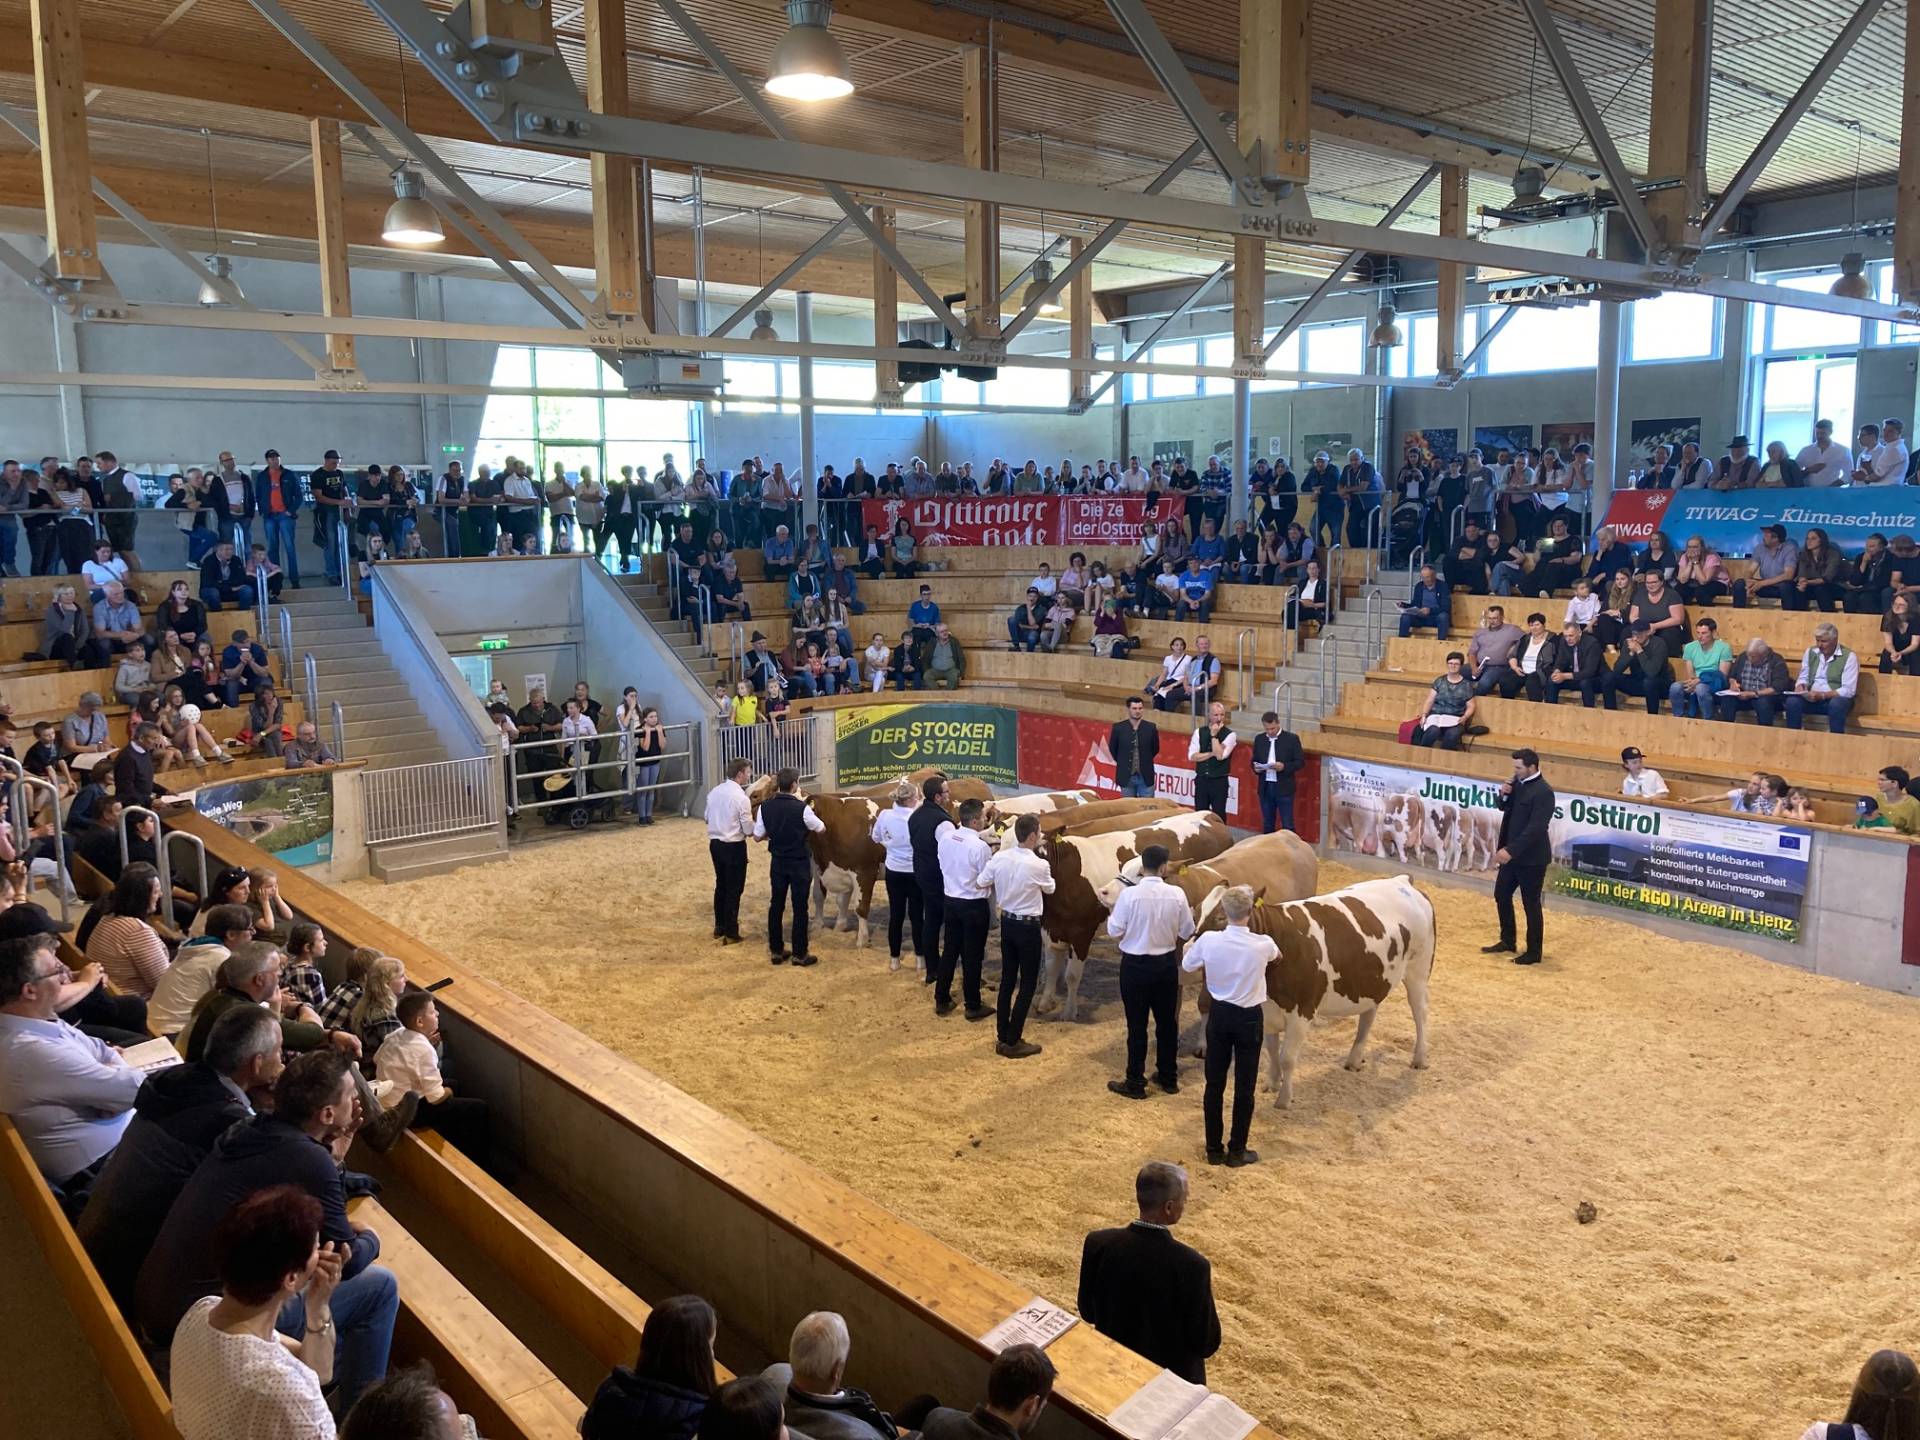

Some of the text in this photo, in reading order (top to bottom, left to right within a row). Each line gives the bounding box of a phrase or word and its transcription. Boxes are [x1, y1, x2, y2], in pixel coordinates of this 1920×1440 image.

[1081, 503, 1103, 517] Die
[1685, 507, 1759, 521] TIWAG
[1779, 508, 1917, 528] Klimaschutz
[1073, 522, 1097, 536] der
[870, 728, 907, 744] DER
[910, 722, 995, 739] STOCKER
[922, 739, 991, 756] STADEL
[1571, 799, 1661, 836] Osttirol
[1650, 842, 1704, 859] kontrollierte
[1706, 851, 1764, 869] Melkbarkeit
[1650, 856, 1704, 873] kontrollierte
[1706, 866, 1787, 887] Eutergesundheit
[1650, 870, 1704, 887] kontrollierte
[1706, 880, 1766, 898] Milchmenge
[1597, 881, 1609, 894] in
[1613, 883, 1635, 900] der
[1639, 887, 1671, 907] RGO
[1683, 897, 1726, 918] Arena
[1730, 905, 1745, 922] in
[1750, 909, 1793, 932] Lienz
